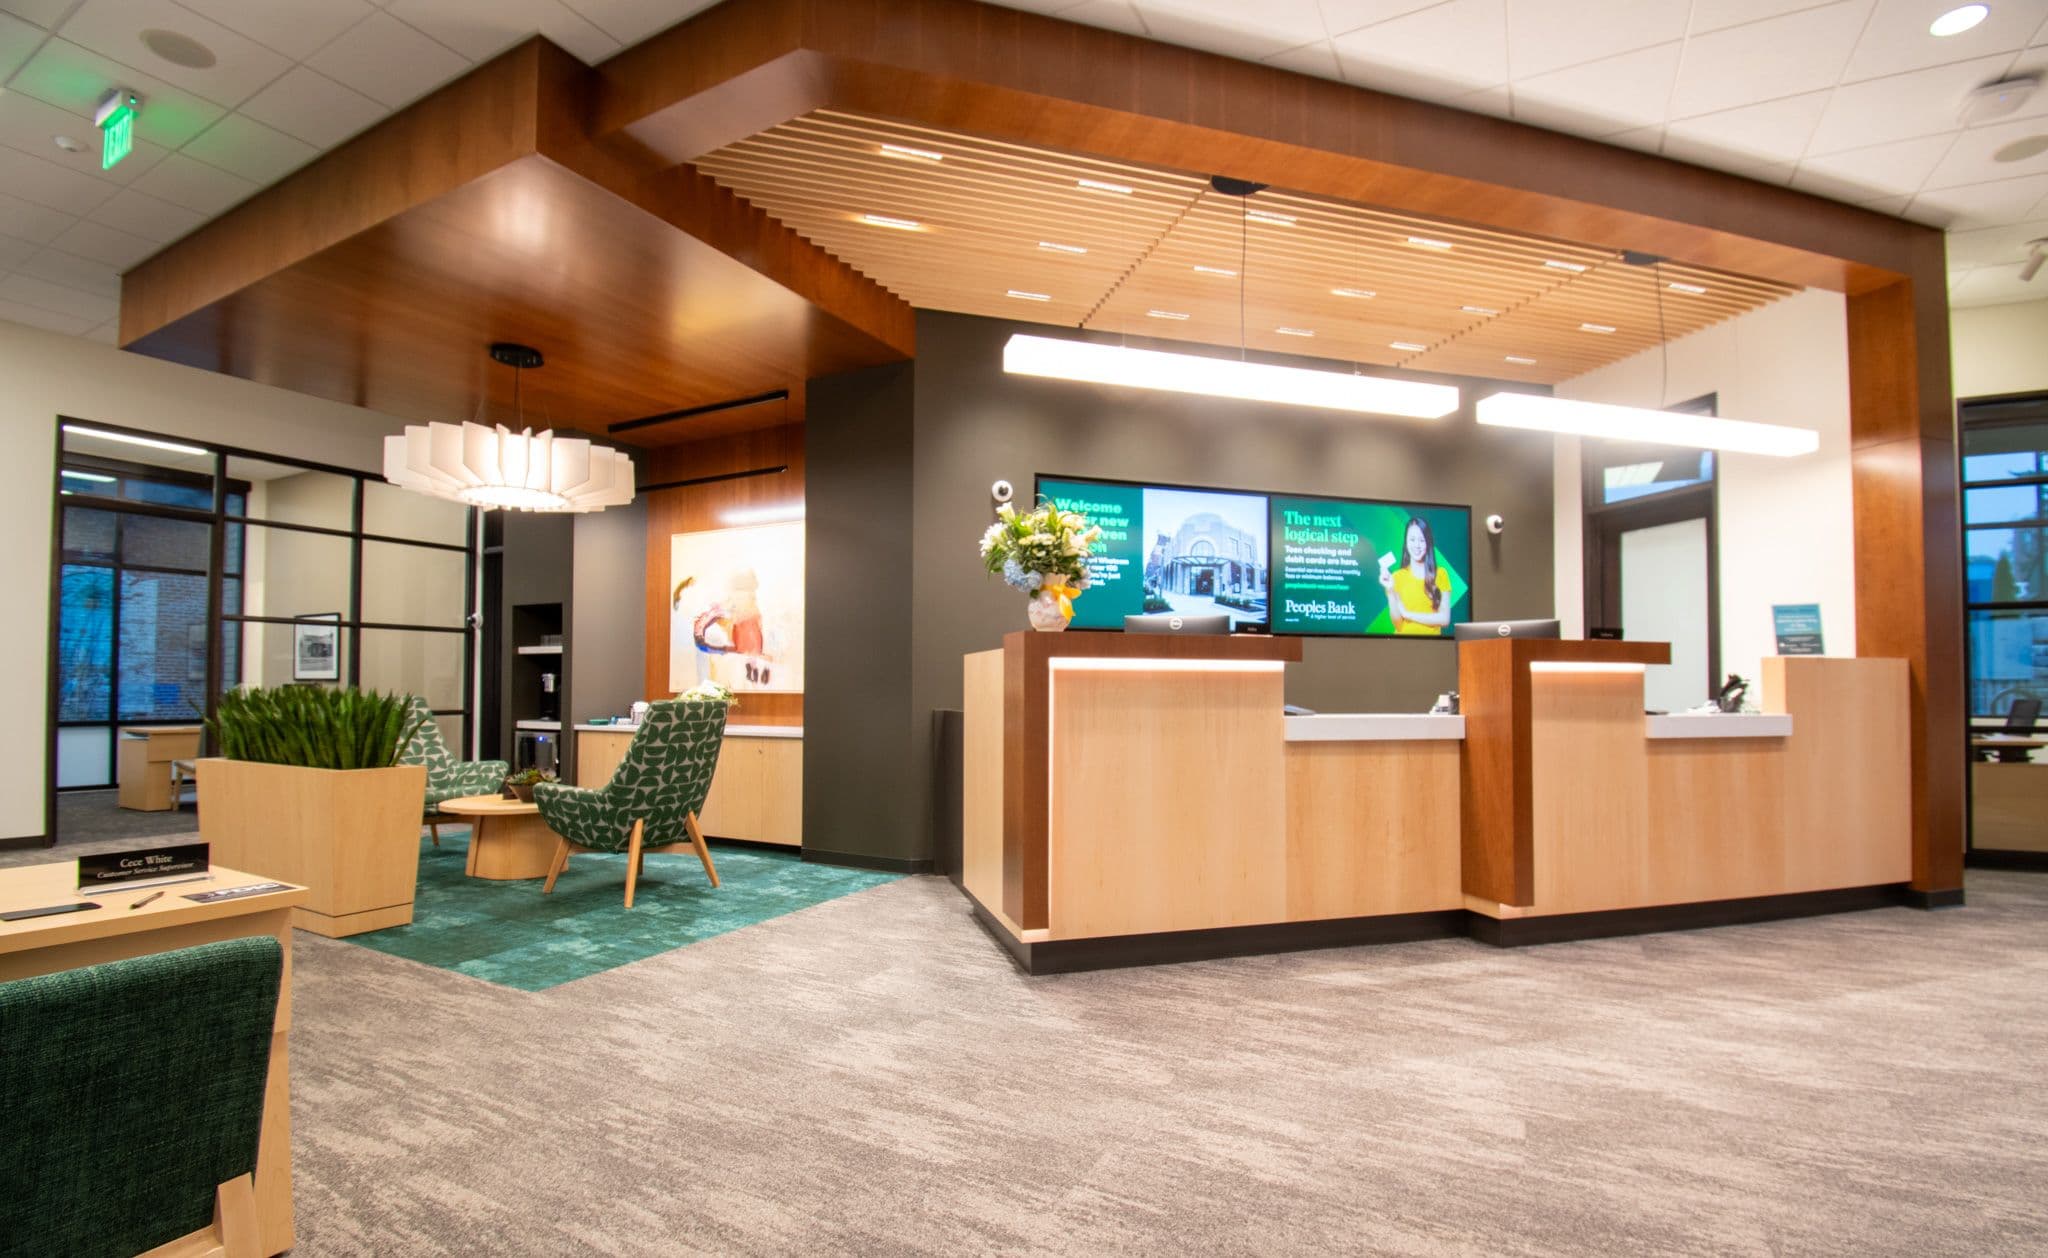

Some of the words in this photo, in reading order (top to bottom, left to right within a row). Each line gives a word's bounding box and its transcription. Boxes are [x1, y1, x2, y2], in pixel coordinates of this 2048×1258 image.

[1055, 498, 1122, 514] Welcome
[1100, 516, 1129, 528] new
[1284, 510, 1310, 526] The
[1313, 514, 1342, 527] next
[1285, 526, 1328, 544] logical
[1331, 532, 1358, 547] step
[1284, 545, 1303, 554] Teen
[1304, 546, 1336, 557] checking
[1285, 555, 1304, 563] debit
[1340, 558, 1358, 566] here.
[1285, 600, 1326, 616] Peoples
[1327, 601, 1356, 614] Bank
[120, 858, 144, 868] Cece
[145, 855, 173, 864] White
[97, 870, 132, 878] Customer
[159, 862, 194, 872] Supervisor
